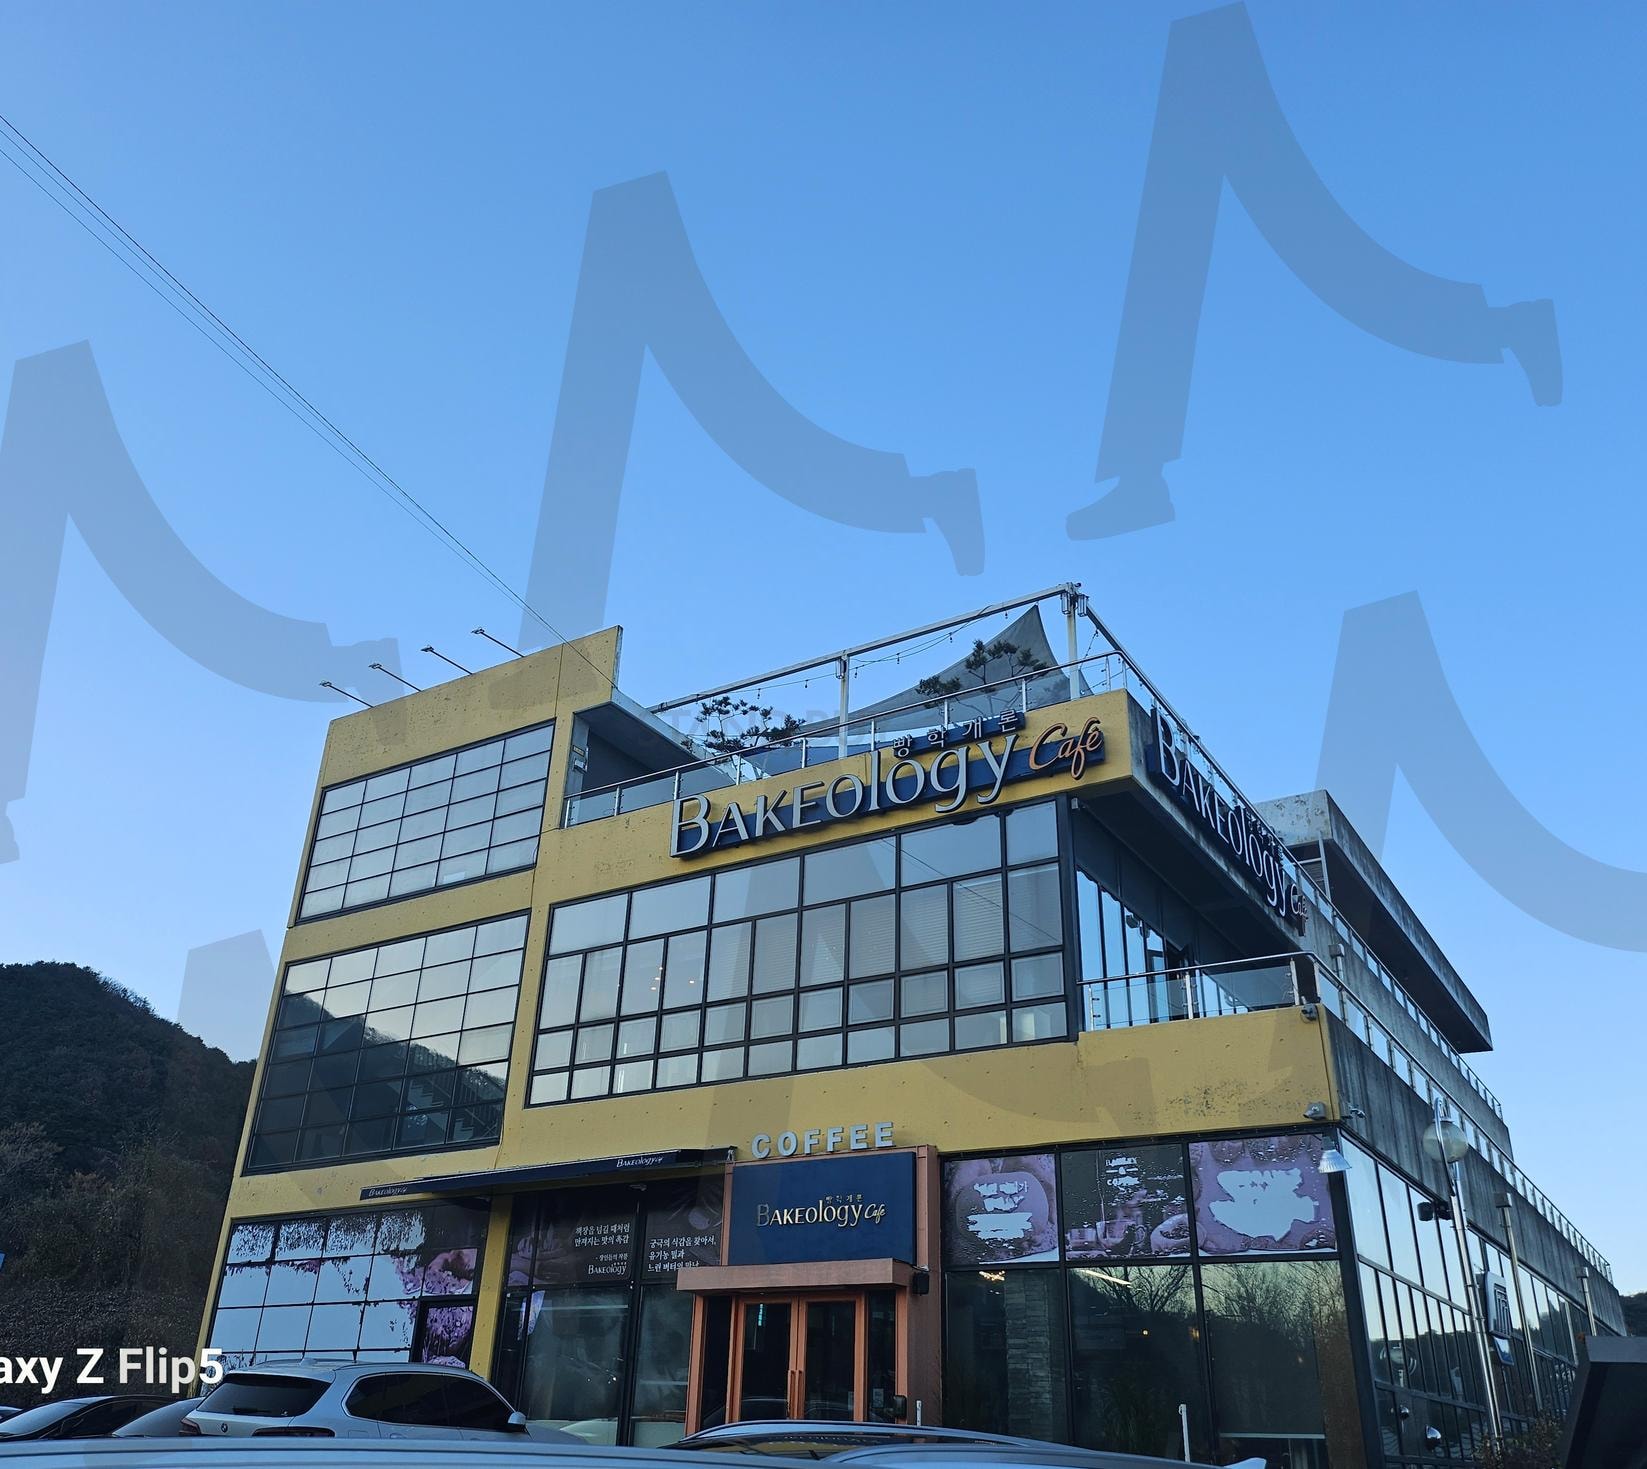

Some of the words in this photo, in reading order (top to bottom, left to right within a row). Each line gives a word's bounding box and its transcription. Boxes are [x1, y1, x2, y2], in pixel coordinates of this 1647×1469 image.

[893, 709, 1019, 758] 빵학개론
[669, 734, 1020, 858] BAKEology
[751, 1122, 894, 1160] COFFEE
[757, 1200, 863, 1228] BAKEology
[650, 1238, 670, 1249] 궁극의
[671, 1237, 692, 1247] 식감을
